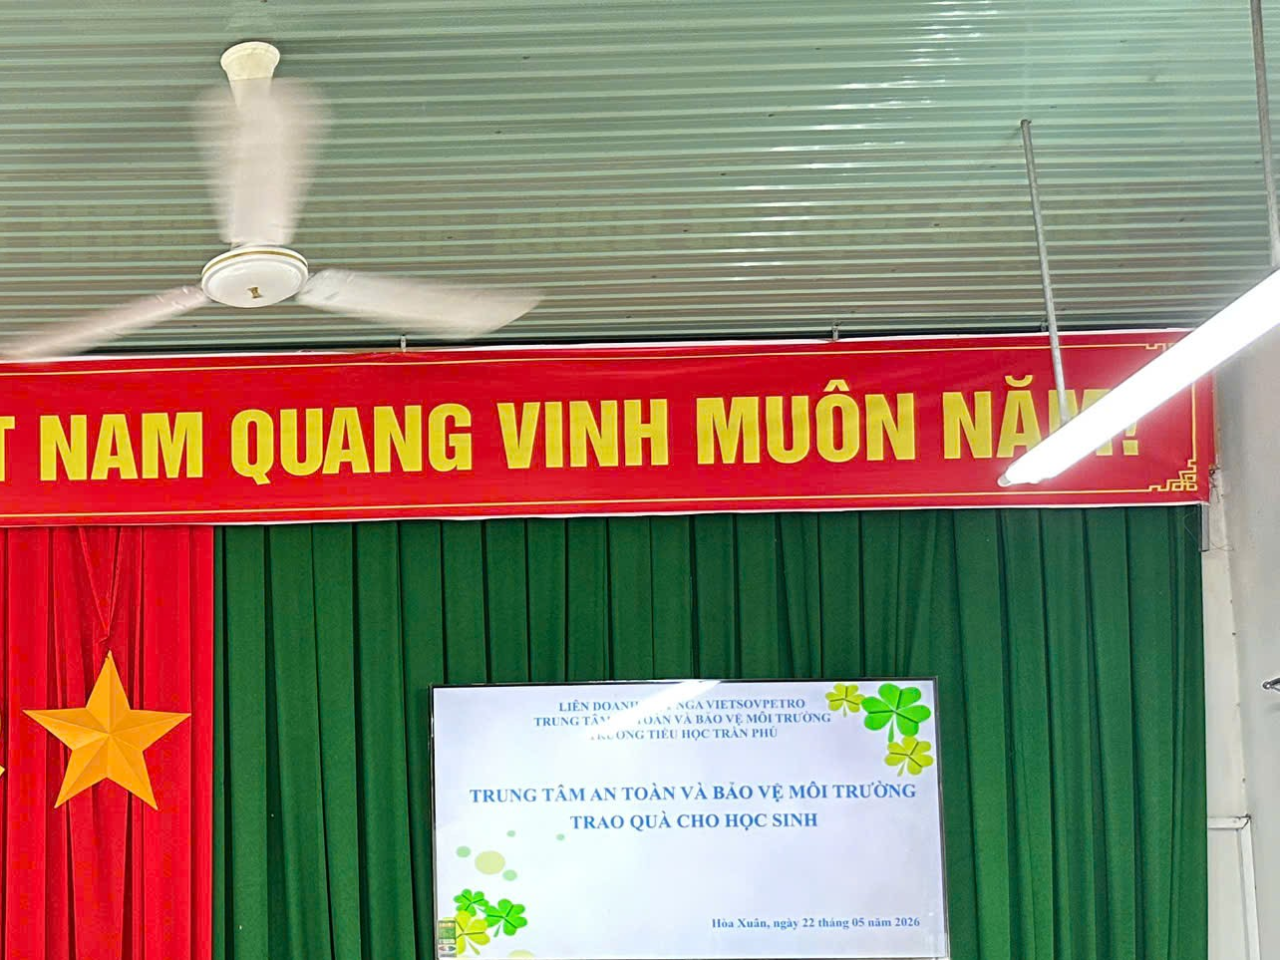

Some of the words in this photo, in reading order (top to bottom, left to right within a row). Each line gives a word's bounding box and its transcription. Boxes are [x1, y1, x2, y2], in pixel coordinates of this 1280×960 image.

[40, 411, 204, 481] NAM
[230, 403, 473, 485] QUANG
[497, 398, 669, 469] VINH
[696, 379, 916, 465] MUÔN
[559, 699, 590, 712] LIÊN
[706, 699, 806, 710] VIETSOVPETRO
[534, 716, 580, 727] TRUNG
[637, 714, 671, 725] OÀN
[674, 713, 692, 724] VÀ
[695, 713, 722, 724] BẢO
[725, 713, 743, 726] VỆ
[746, 711, 772, 723] MÔI
[775, 712, 831, 723] TRƯỜNG
[681, 728, 710, 741] HỌC
[713, 726, 748, 739] TRẦN
[751, 725, 778, 738] PHÚ
[470, 788, 537, 803] TRUNG
[542, 784, 585, 802] TÂM
[590, 787, 616, 801] AN
[622, 783, 675, 801] TOÀN
[681, 782, 707, 800] VÀ
[713, 782, 753, 800] BẢO
[758, 783, 784, 802] VỆ
[789, 781, 828, 799] MÔI
[832, 780, 916, 799] TRƯỜNG
[570, 814, 625, 830] TRAO
[630, 810, 671, 831] QUÀ
[676, 814, 719, 828] CHO
[725, 813, 767, 831] HỌC
[772, 813, 818, 827] SINH
[712, 918, 734, 928] Hòa
[737, 918, 770, 929] Xuân,
[773, 918, 798, 930] ngày
[802, 918, 815, 928] 22
[818, 917, 850, 929] tháng
[852, 917, 865, 927] 05
[868, 917, 891, 927] năm
[895, 917, 920, 927] 2026
